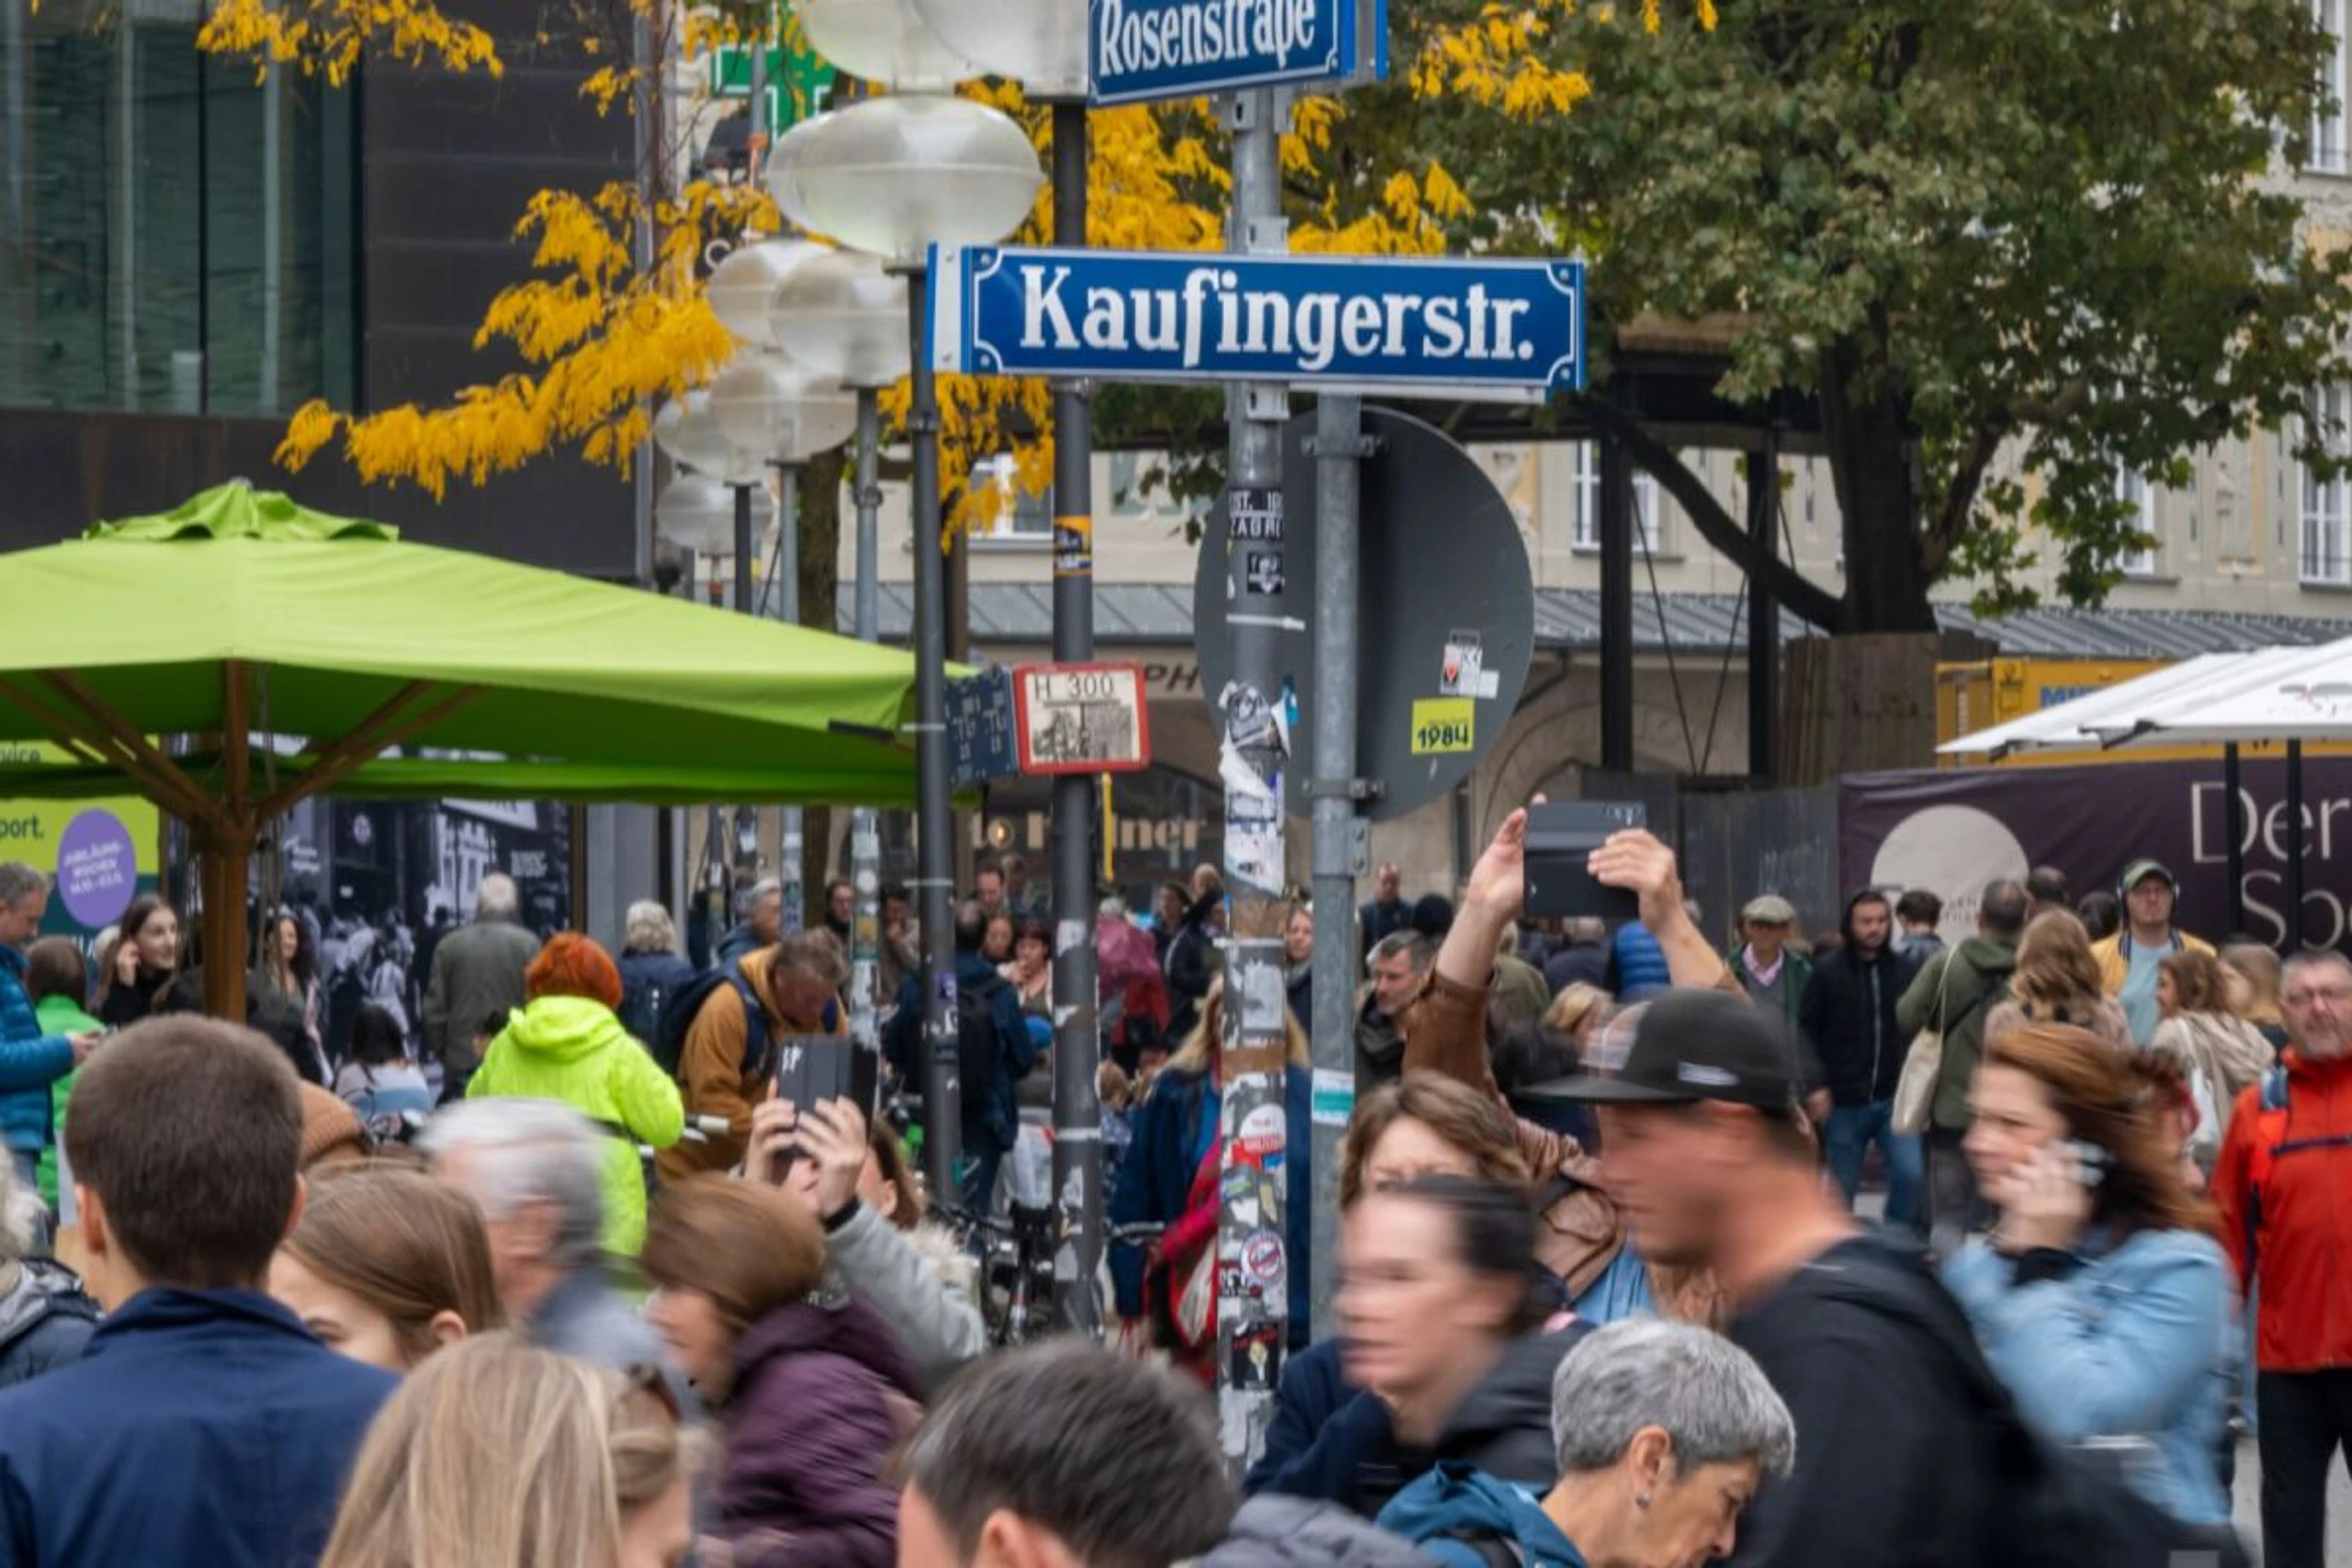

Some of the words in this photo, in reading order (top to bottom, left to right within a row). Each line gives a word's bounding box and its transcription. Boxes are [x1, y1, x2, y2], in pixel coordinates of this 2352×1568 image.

[1099, 0, 1316, 76] Rosenstraße
[1019, 264, 1535, 370] Kaufingerstr.
[1035, 675, 1051, 702] H
[1068, 673, 1114, 698] 300
[1418, 723, 1469, 749] 1984
[2190, 780, 2351, 863] Der
